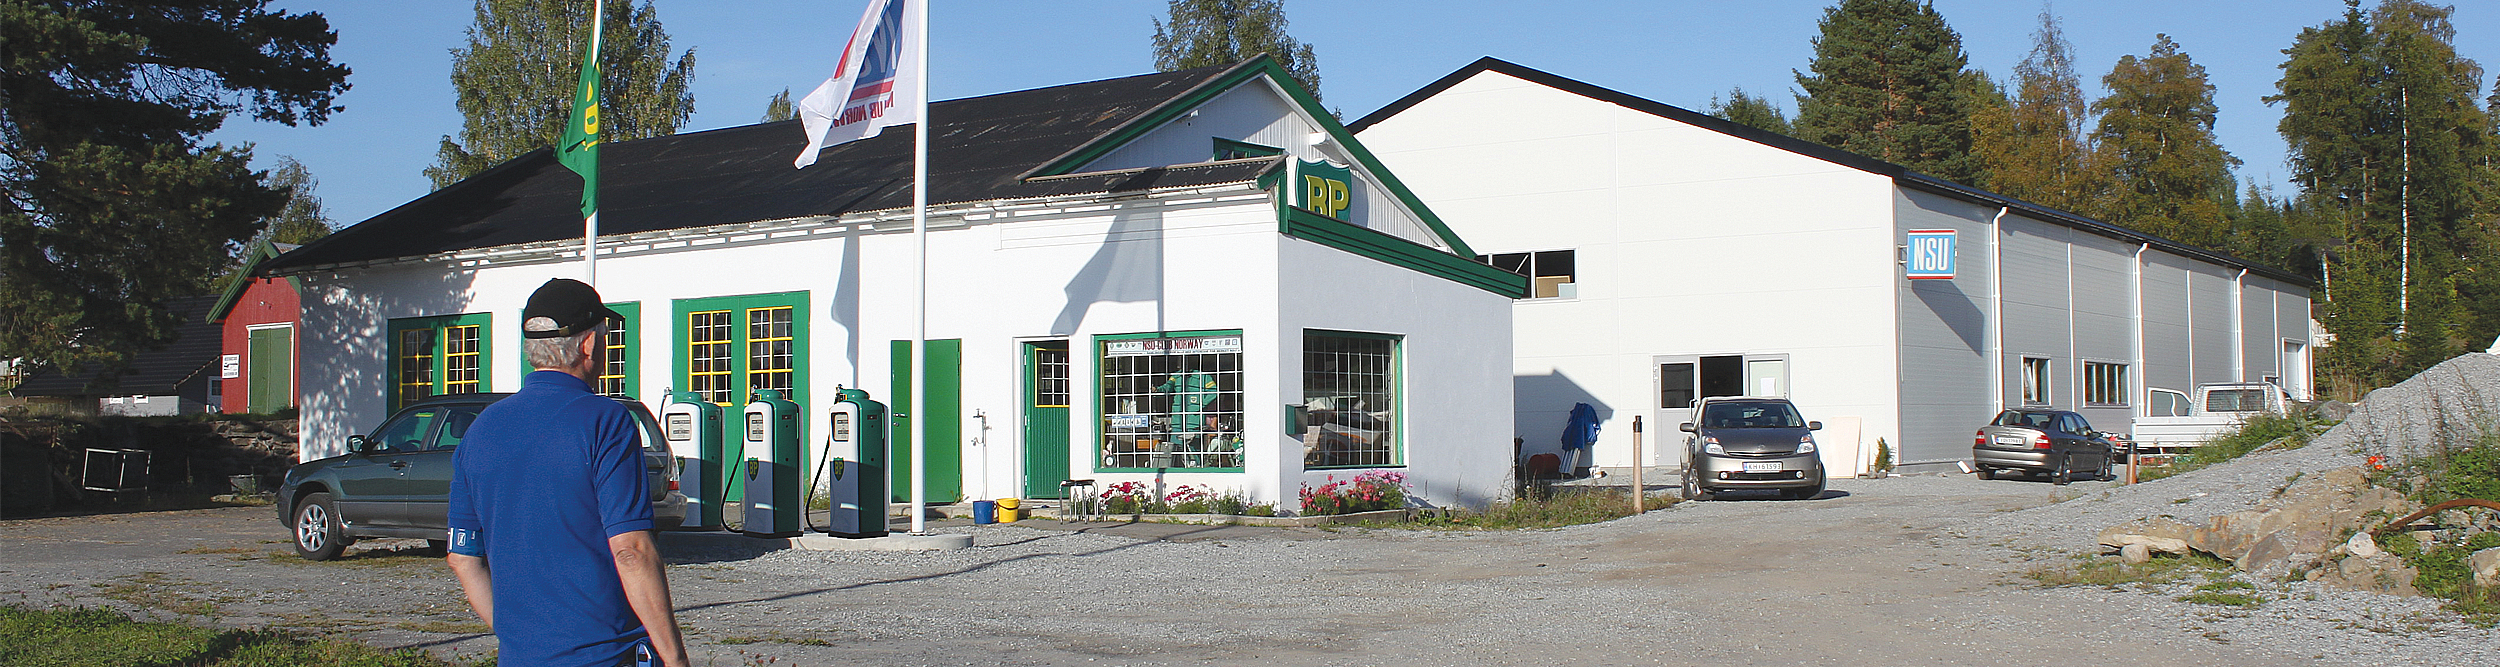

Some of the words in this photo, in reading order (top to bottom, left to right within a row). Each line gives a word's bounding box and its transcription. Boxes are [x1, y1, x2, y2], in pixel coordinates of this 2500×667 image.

[1304, 174, 1349, 218] BP
[1913, 237, 1950, 271] NSU
[1142, 340, 1173, 351] NSU-CLUB
[1174, 338, 1204, 350] NORWAY
[749, 461, 758, 474] BP
[834, 461, 844, 474] BP
